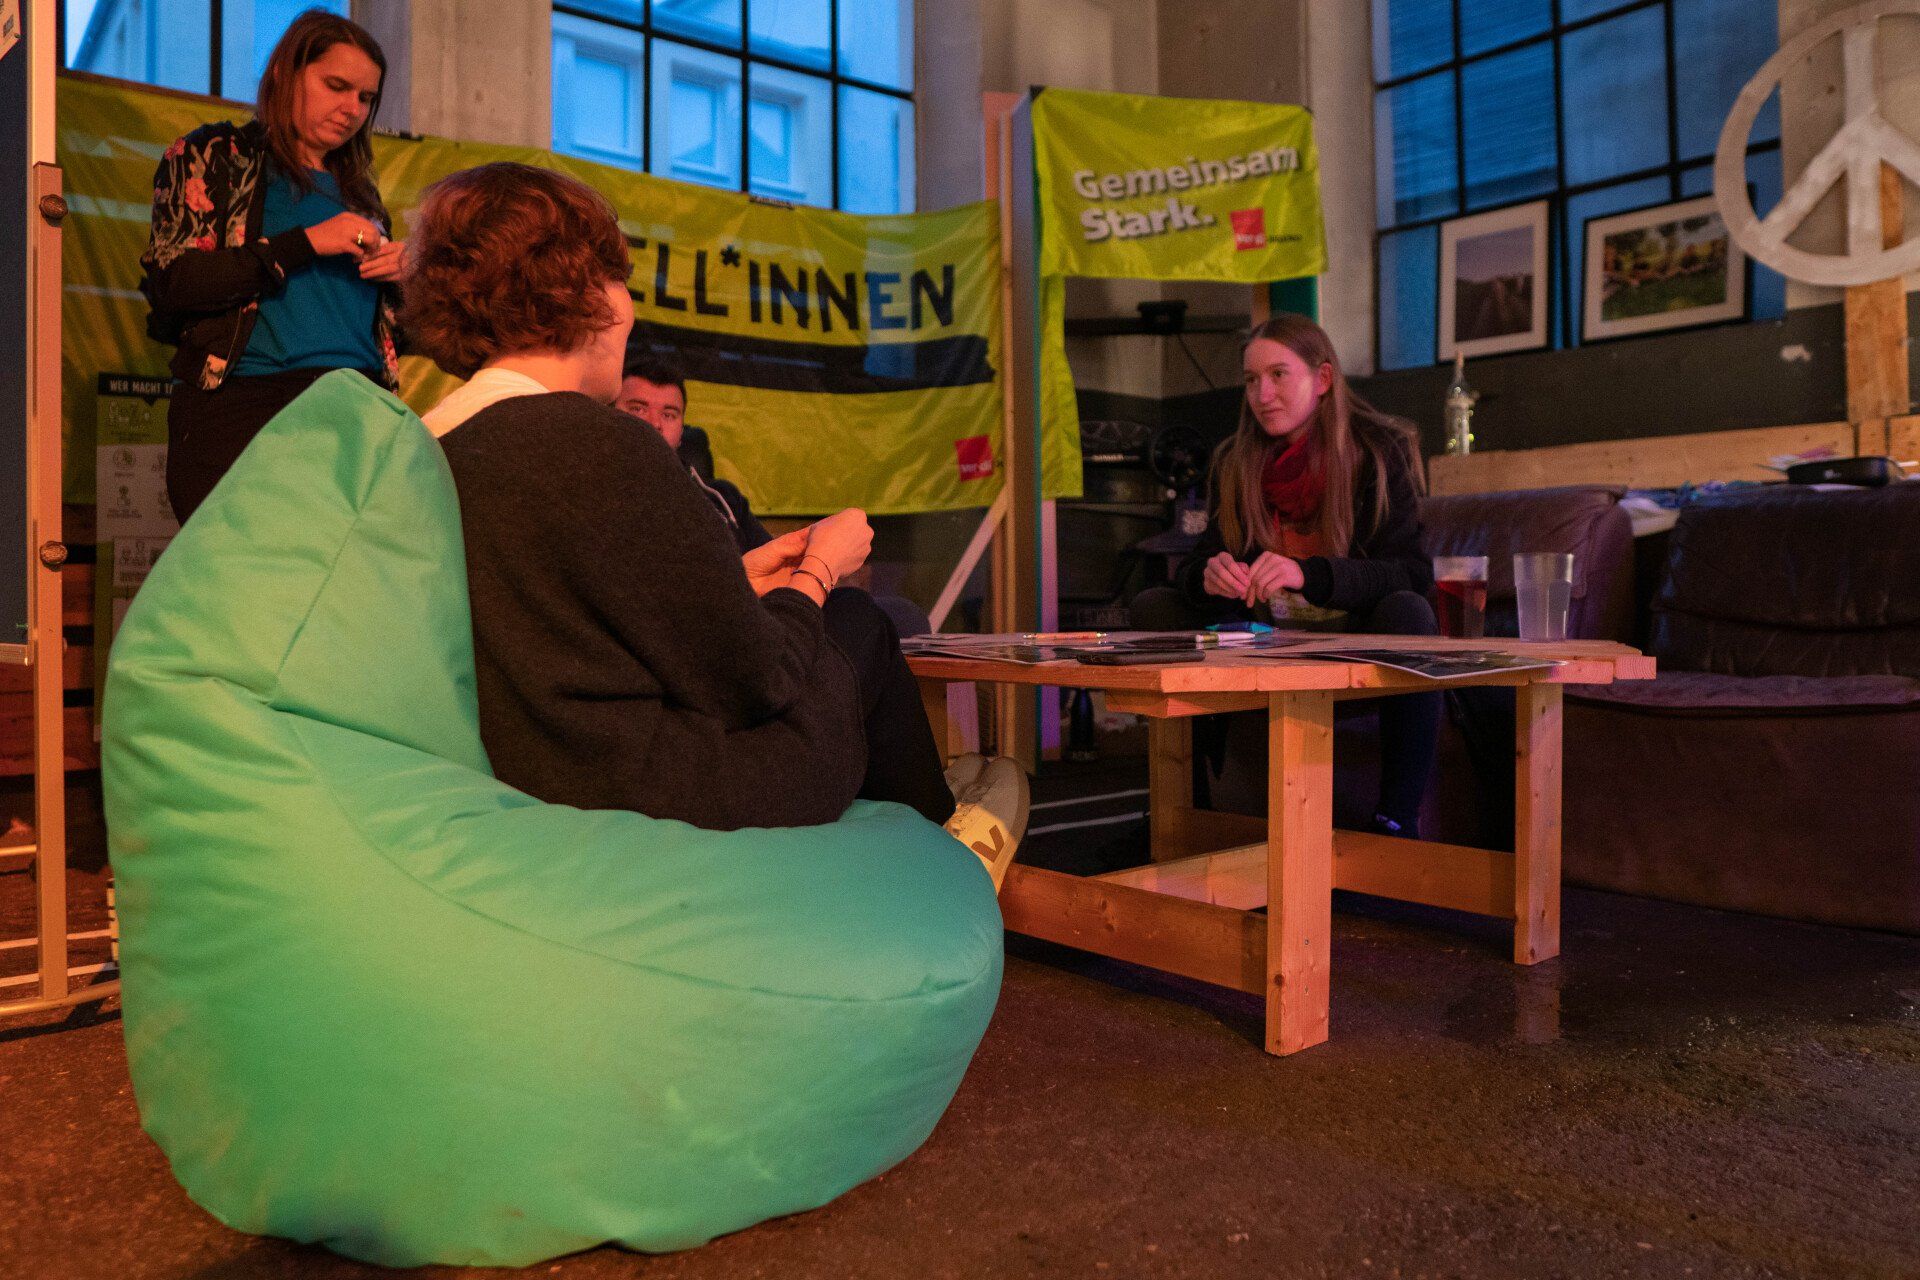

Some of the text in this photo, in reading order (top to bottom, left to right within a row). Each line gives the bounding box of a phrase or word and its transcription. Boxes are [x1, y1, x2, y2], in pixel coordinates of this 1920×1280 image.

[1073, 146, 1299, 201] Gemeinsam
[1080, 198, 1217, 242] Stark.
[110, 380, 129, 392] WER
[133, 381, 161, 394] MACHT
